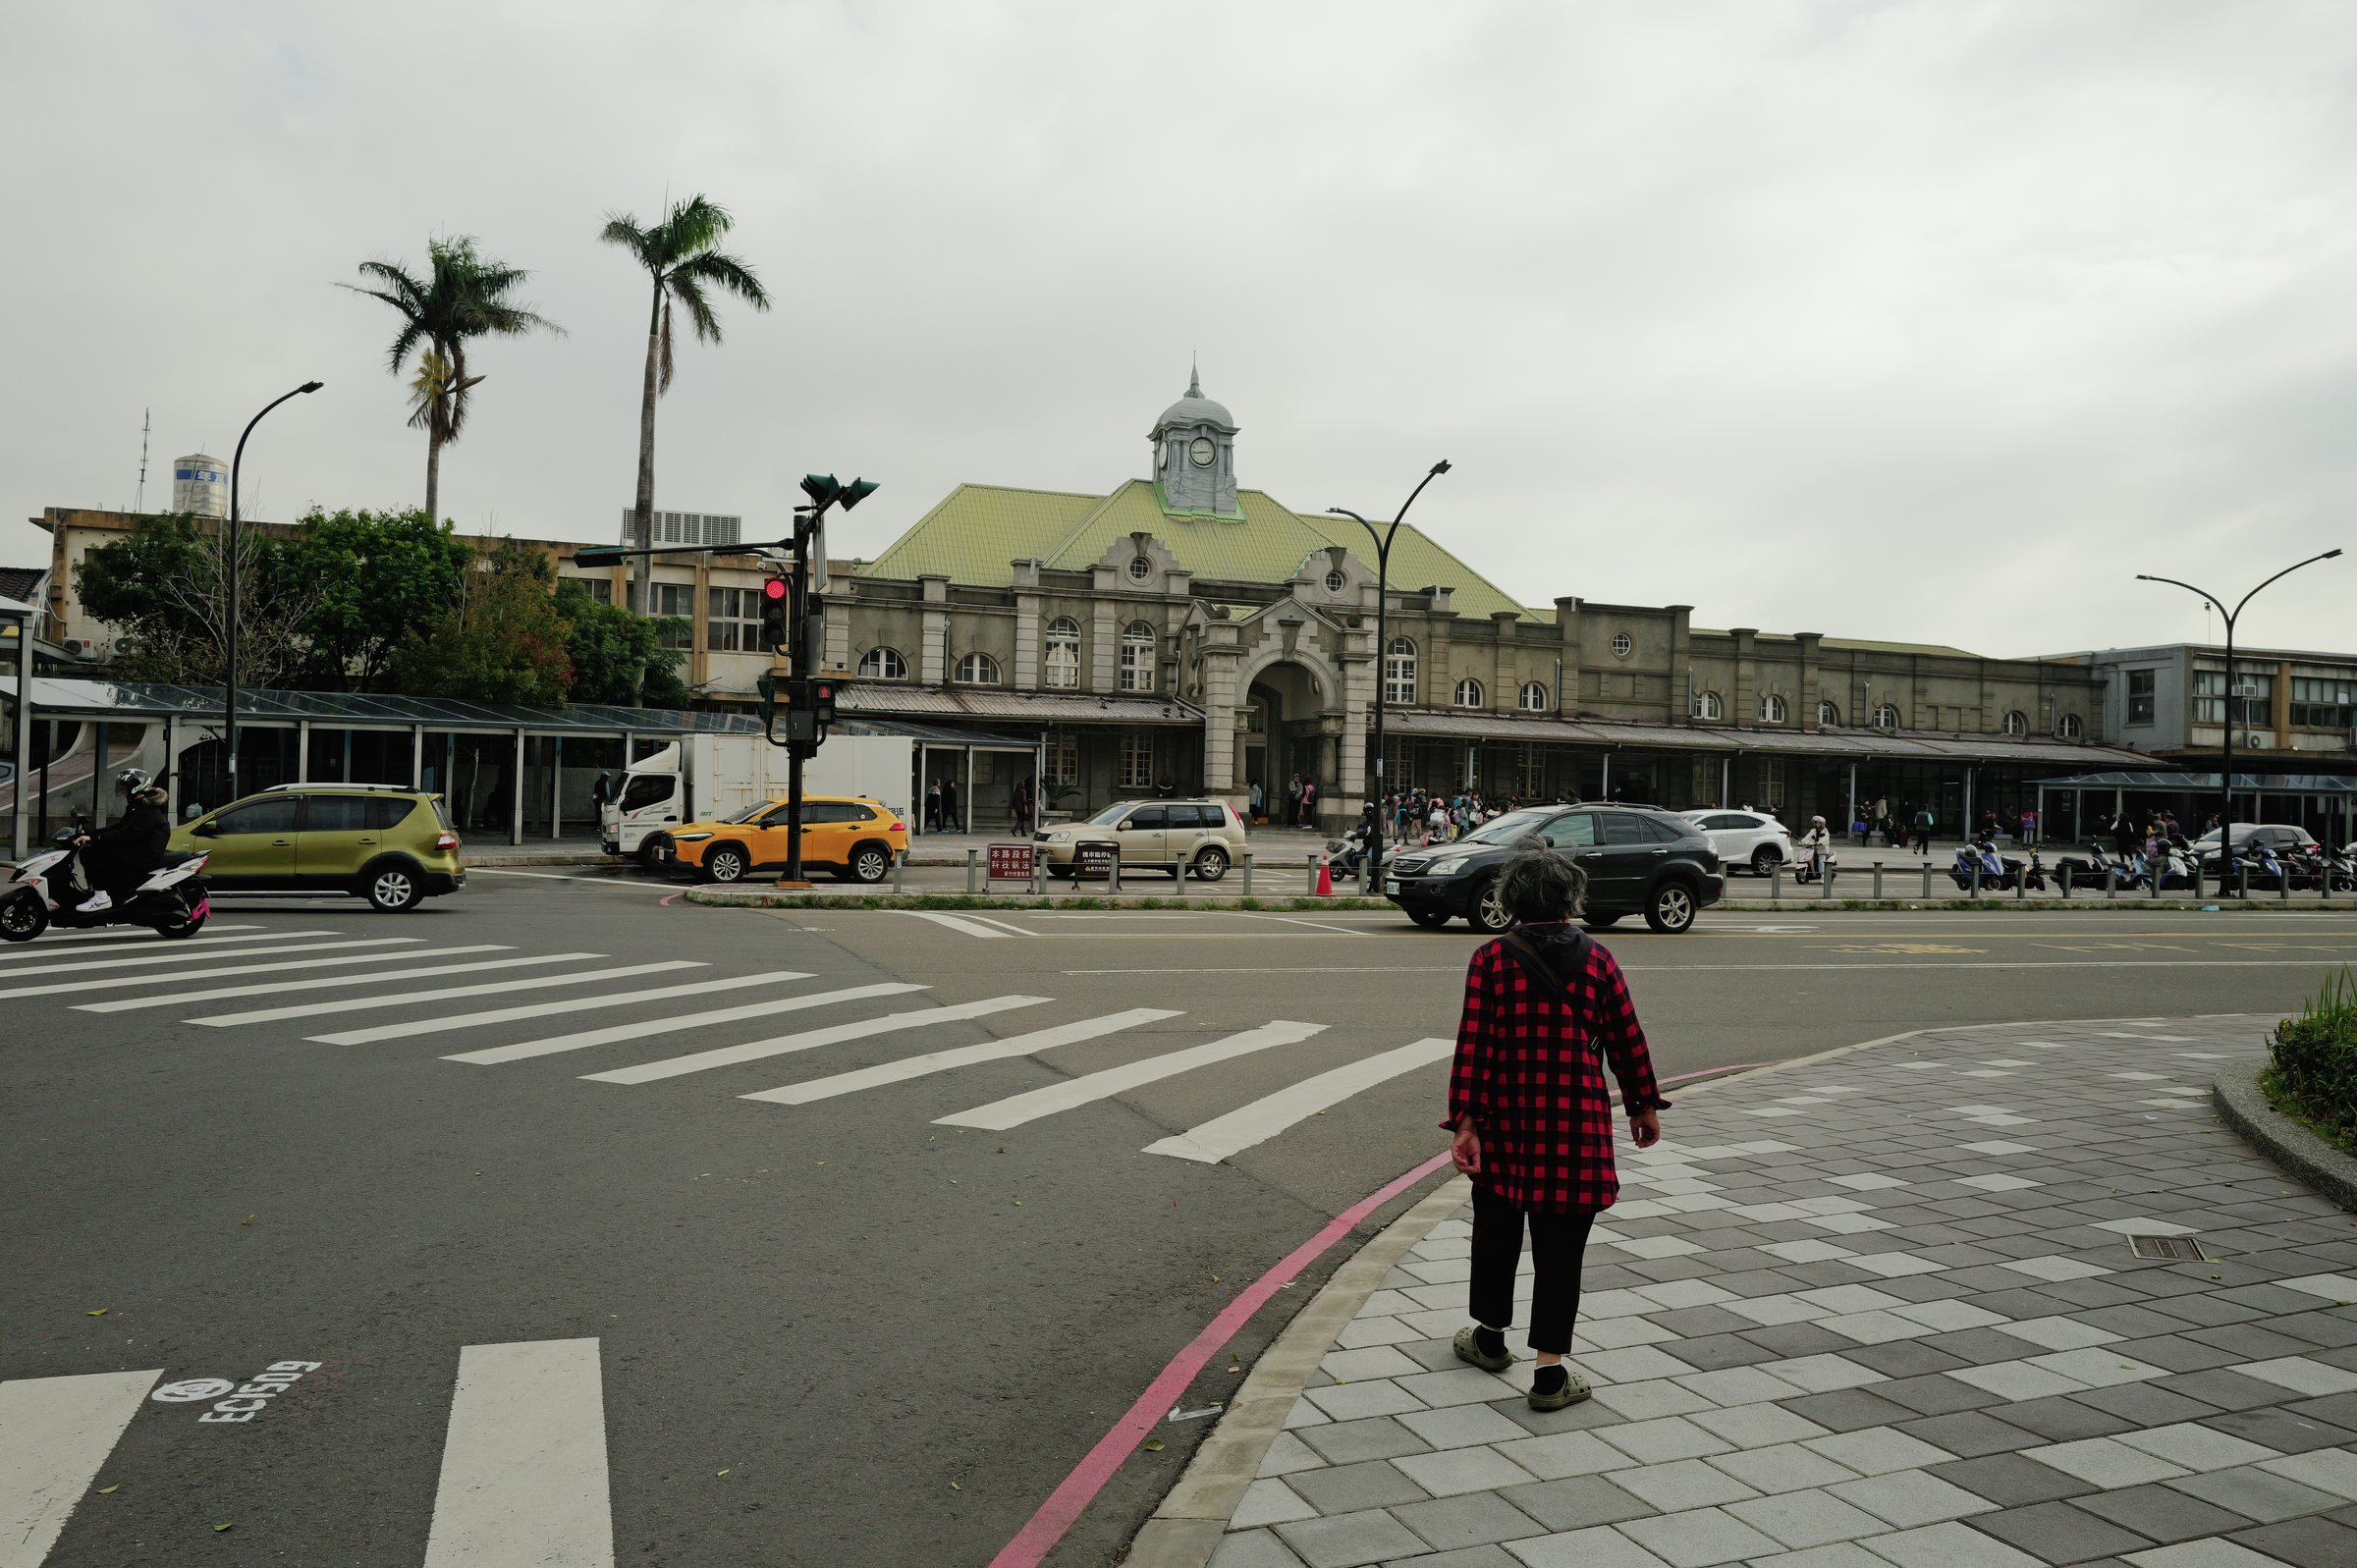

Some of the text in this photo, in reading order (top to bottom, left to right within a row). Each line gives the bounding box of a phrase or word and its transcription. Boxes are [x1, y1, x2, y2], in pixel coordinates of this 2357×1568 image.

[991, 849, 1030, 859] 本路段採
[991, 860, 1030, 870] 科技執法
